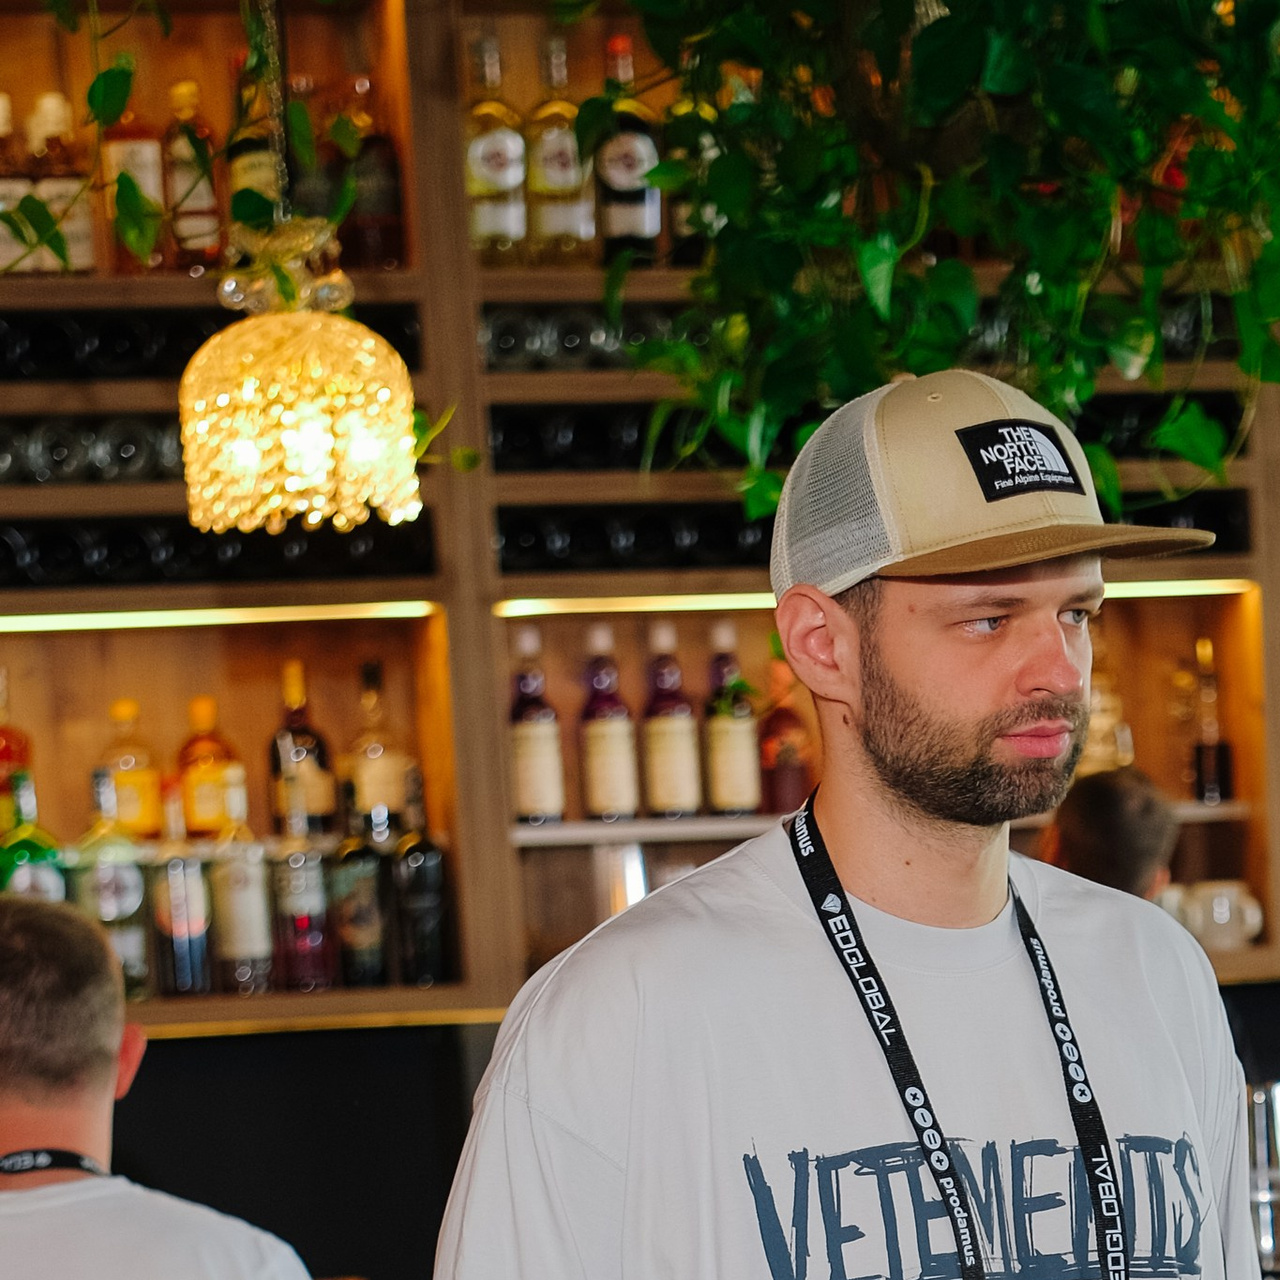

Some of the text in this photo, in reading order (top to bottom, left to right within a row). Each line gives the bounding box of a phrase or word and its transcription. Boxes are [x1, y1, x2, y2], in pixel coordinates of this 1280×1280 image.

[980, 441, 1040, 464] NORTH
[998, 426, 1033, 442] THE
[1003, 455, 1047, 474] FACE
[828, 913, 896, 1046] EDGLOBAL
[1030, 937, 1066, 1019] prodamus
[939, 1177, 976, 1267] prodamus
